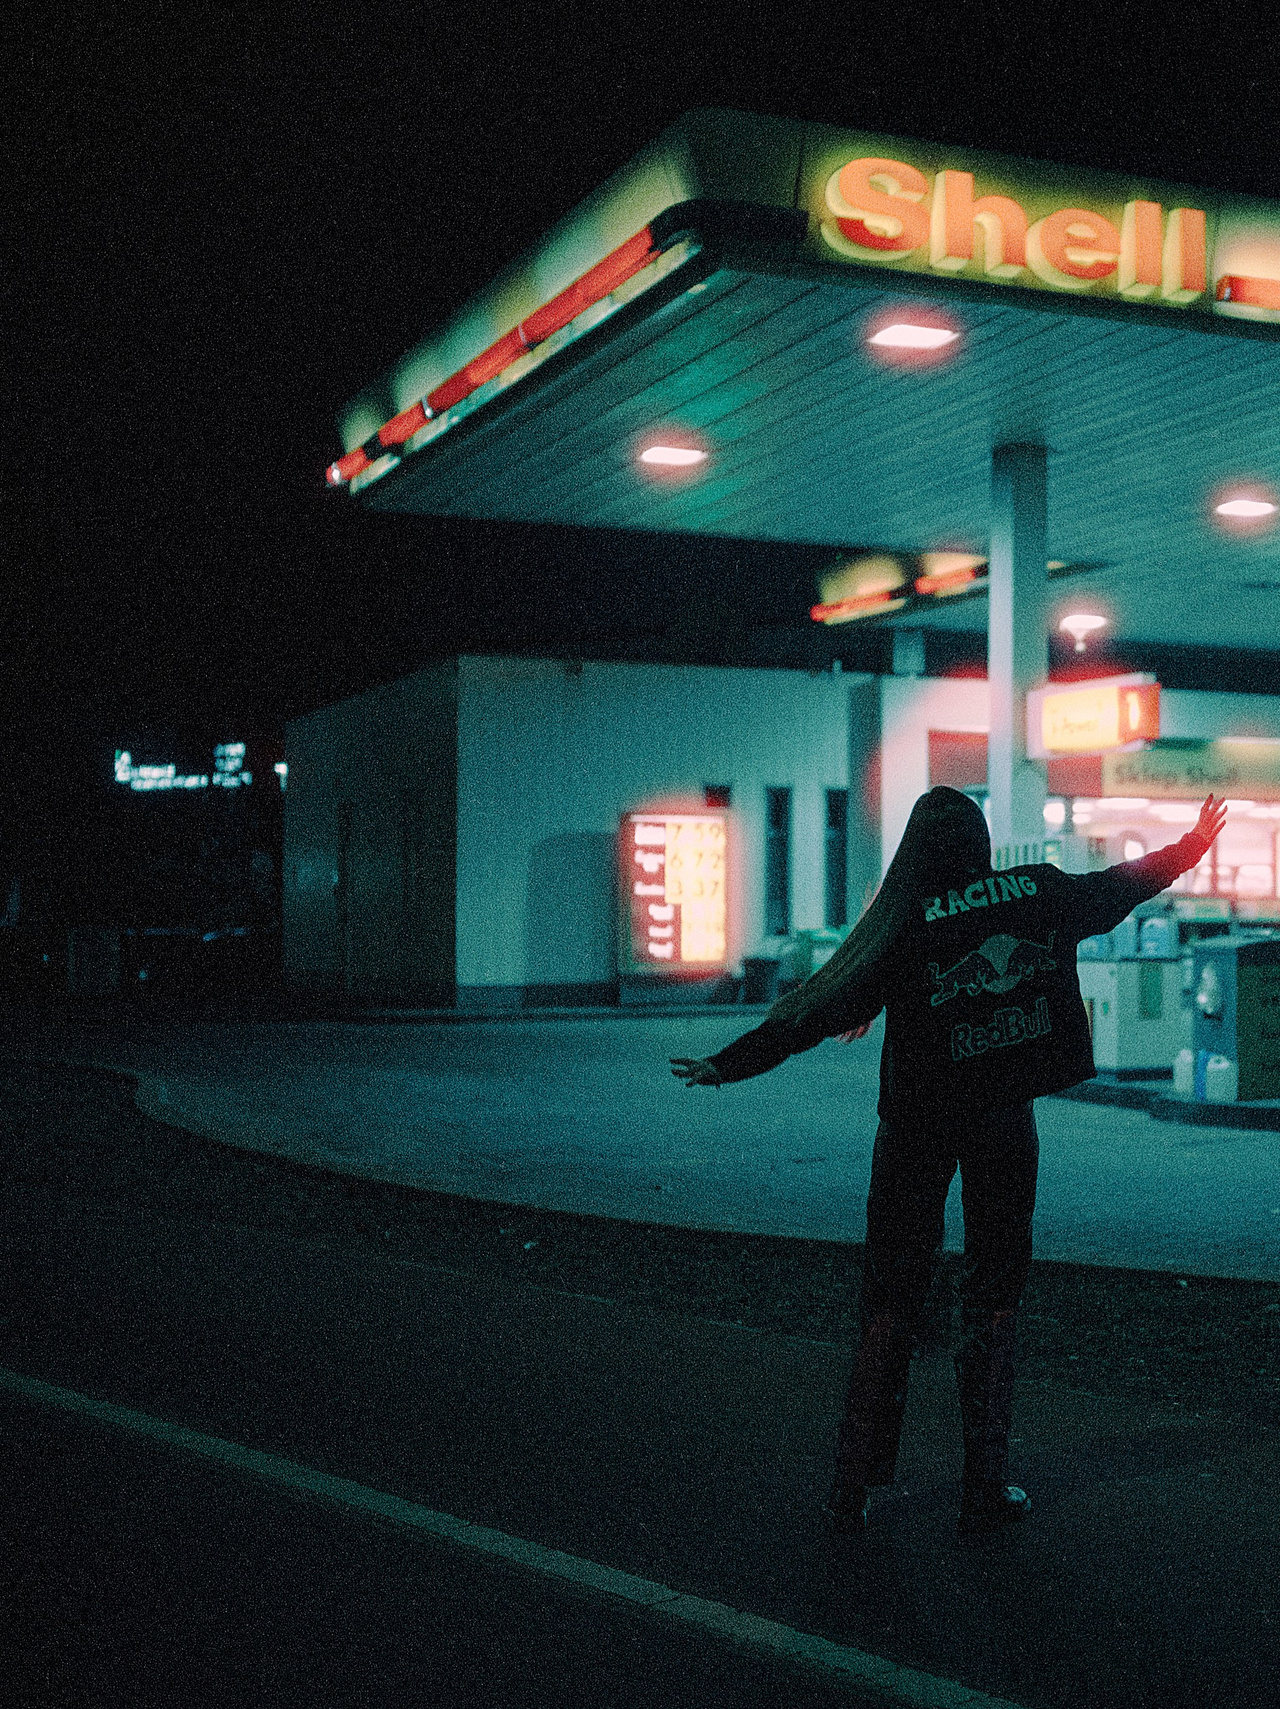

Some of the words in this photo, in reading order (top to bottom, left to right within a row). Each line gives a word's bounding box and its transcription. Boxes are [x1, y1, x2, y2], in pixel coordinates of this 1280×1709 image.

[821, 156, 1207, 304] Shell
[1126, 691, 1141, 731] 1
[1185, 765, 1240, 788] Shell
[923, 874, 1038, 922] RACING
